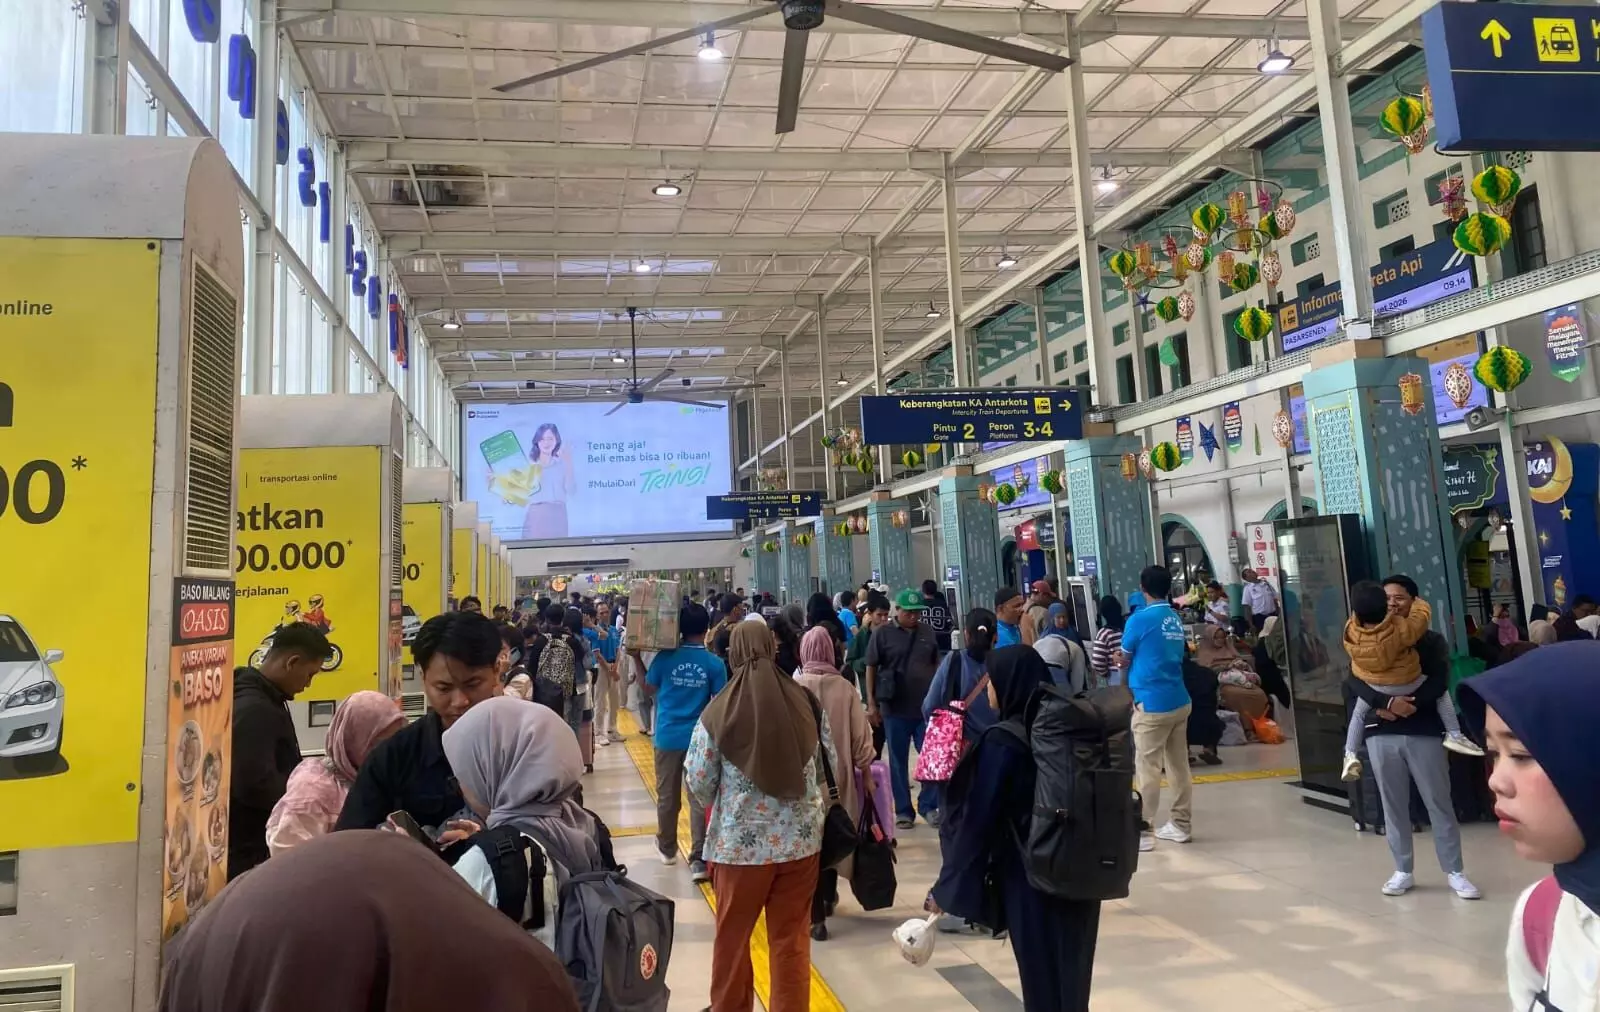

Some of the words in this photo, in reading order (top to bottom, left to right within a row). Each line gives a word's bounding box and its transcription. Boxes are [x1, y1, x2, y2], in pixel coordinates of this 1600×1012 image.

[1400, 254, 1423, 276] Api
[1443, 277, 1466, 290] 09.14
[0, 299, 53, 316] nline
[1389, 297, 1408, 309] 2026
[1284, 325, 1327, 346] PASARSENEN
[900, 399, 967, 409] Keberangkatan
[968, 398, 982, 407] KA
[985, 398, 1028, 407] Antarkota
[995, 408, 1029, 416] Departures
[933, 423, 957, 432] Pintu
[963, 423, 976, 440] 2
[989, 422, 1015, 431] Peron
[587, 441, 625, 453] Tenang
[627, 440, 646, 451] aja!
[587, 454, 606, 463] Beli
[609, 454, 636, 462] emas
[639, 452, 660, 461] bisa
[677, 451, 711, 460] ribuan!
[1527, 458, 1553, 475] KAI
[259, 474, 310, 485] transportasi
[312, 473, 338, 481] online
[588, 479, 636, 489] #MulaiDari
[181, 584, 202, 600] BASO
[202, 585, 230, 600] MALANG
[183, 608, 228, 632] OASIS
[671, 661, 707, 679] PORTER
[184, 667, 223, 706] BASO
